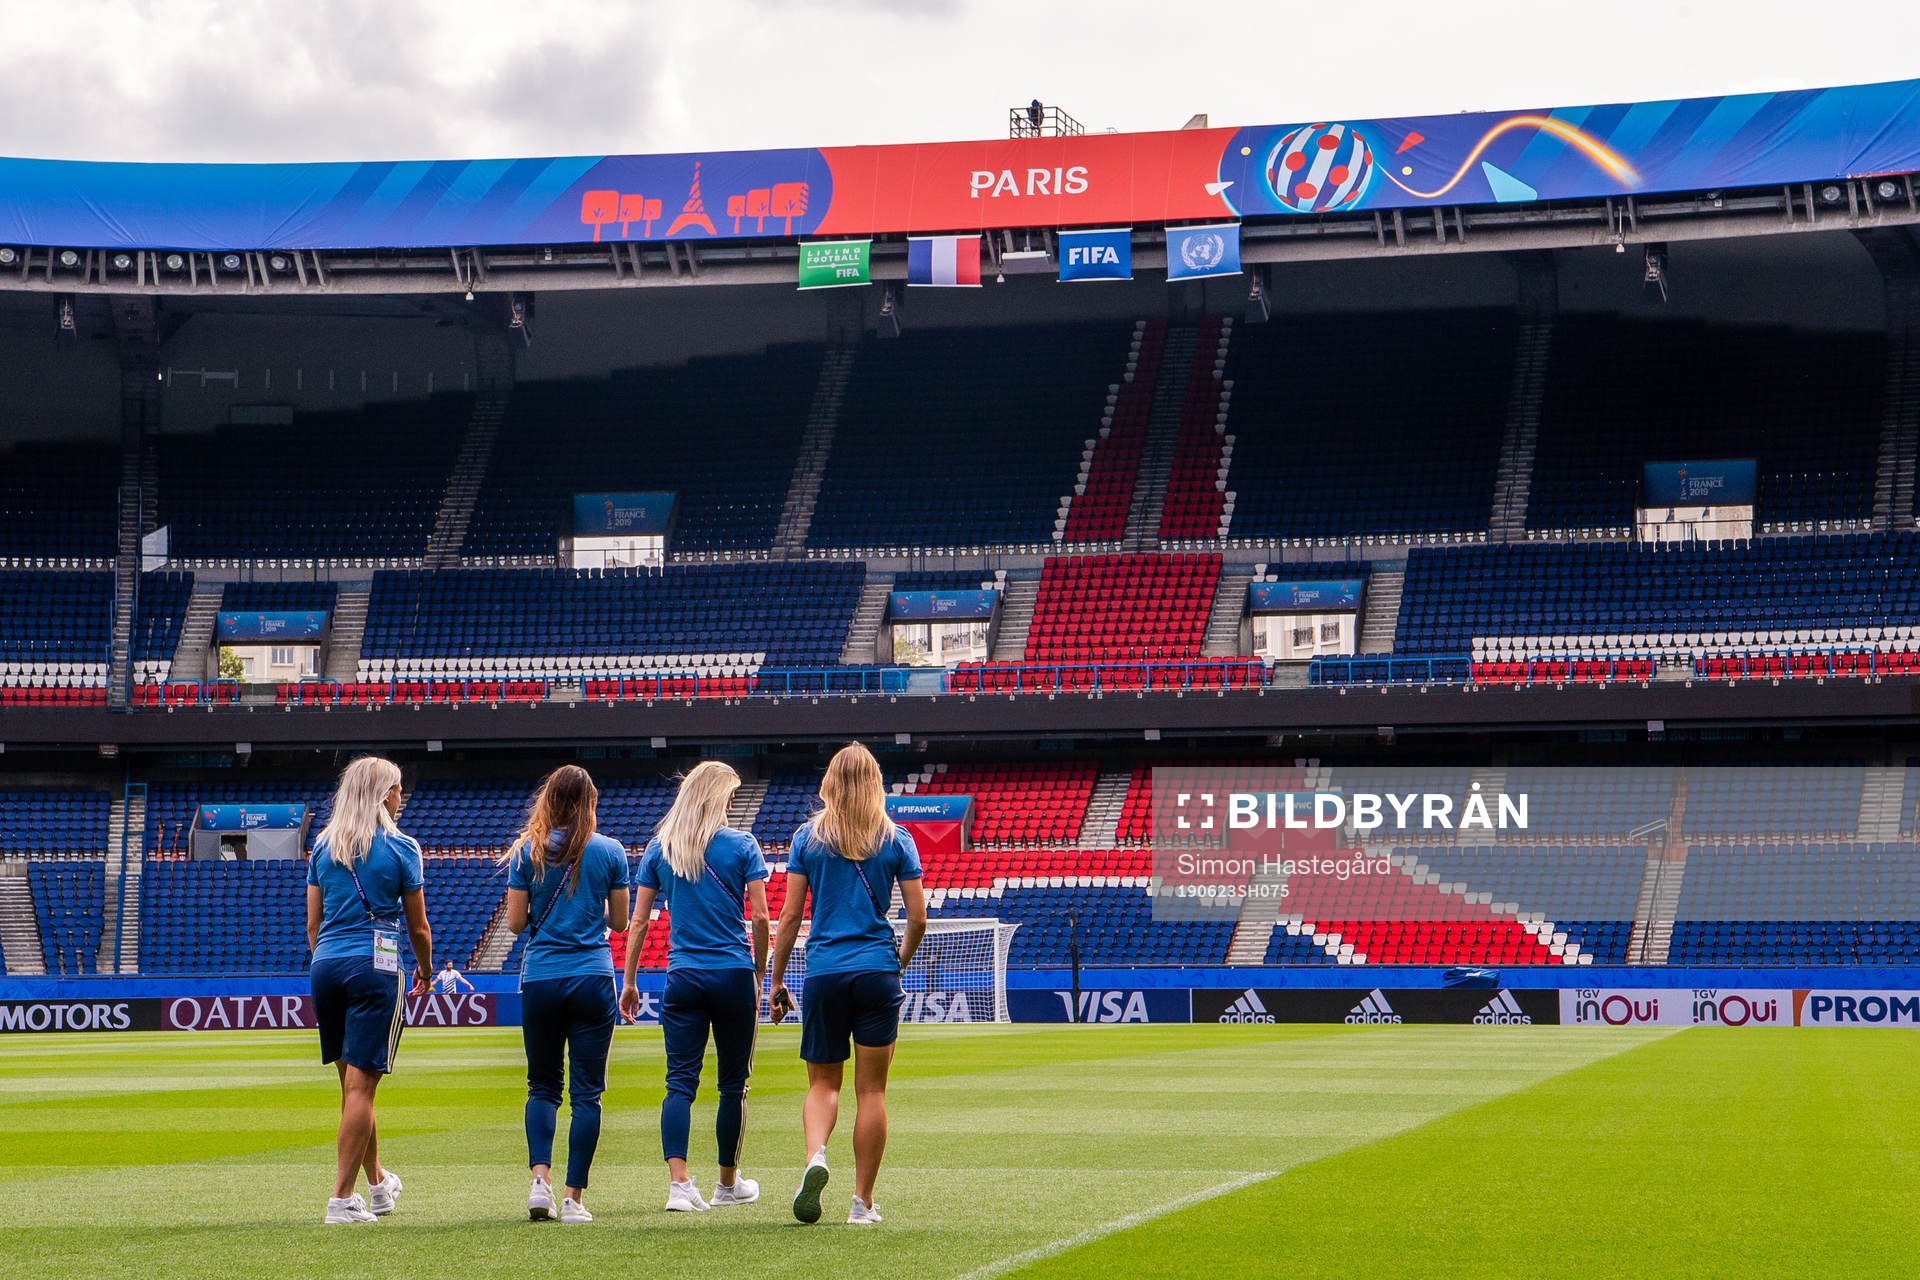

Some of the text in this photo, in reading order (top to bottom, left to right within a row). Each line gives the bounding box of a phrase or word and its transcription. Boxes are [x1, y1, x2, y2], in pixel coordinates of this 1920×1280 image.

[969, 166, 1089, 198] PARIS
[807, 247, 861, 257] LIVING
[1068, 246, 1120, 265] FIFA
[807, 254, 860, 264] FOOTBALL
[836, 268, 860, 278] FIFA
[1689, 479, 1724, 488] FRANCE
[1689, 488, 1709, 496] 2019
[614, 510, 646, 519] FRANCE
[614, 519, 632, 527] 2019
[897, 805, 941, 814] #FIFAWWC
[1575, 989, 1600, 999] TGV
[1691, 989, 1717, 999] TGV
[1053, 990, 1149, 1023] VISA
[1810, 995, 1920, 1022] PROM
[0, 1003, 131, 1031] MOTORS
[169, 996, 305, 1032] QATAR
[1218, 1011, 1276, 1025] adidas
[1344, 1011, 1402, 1025] adidas
[1473, 1011, 1532, 1025] adidas
